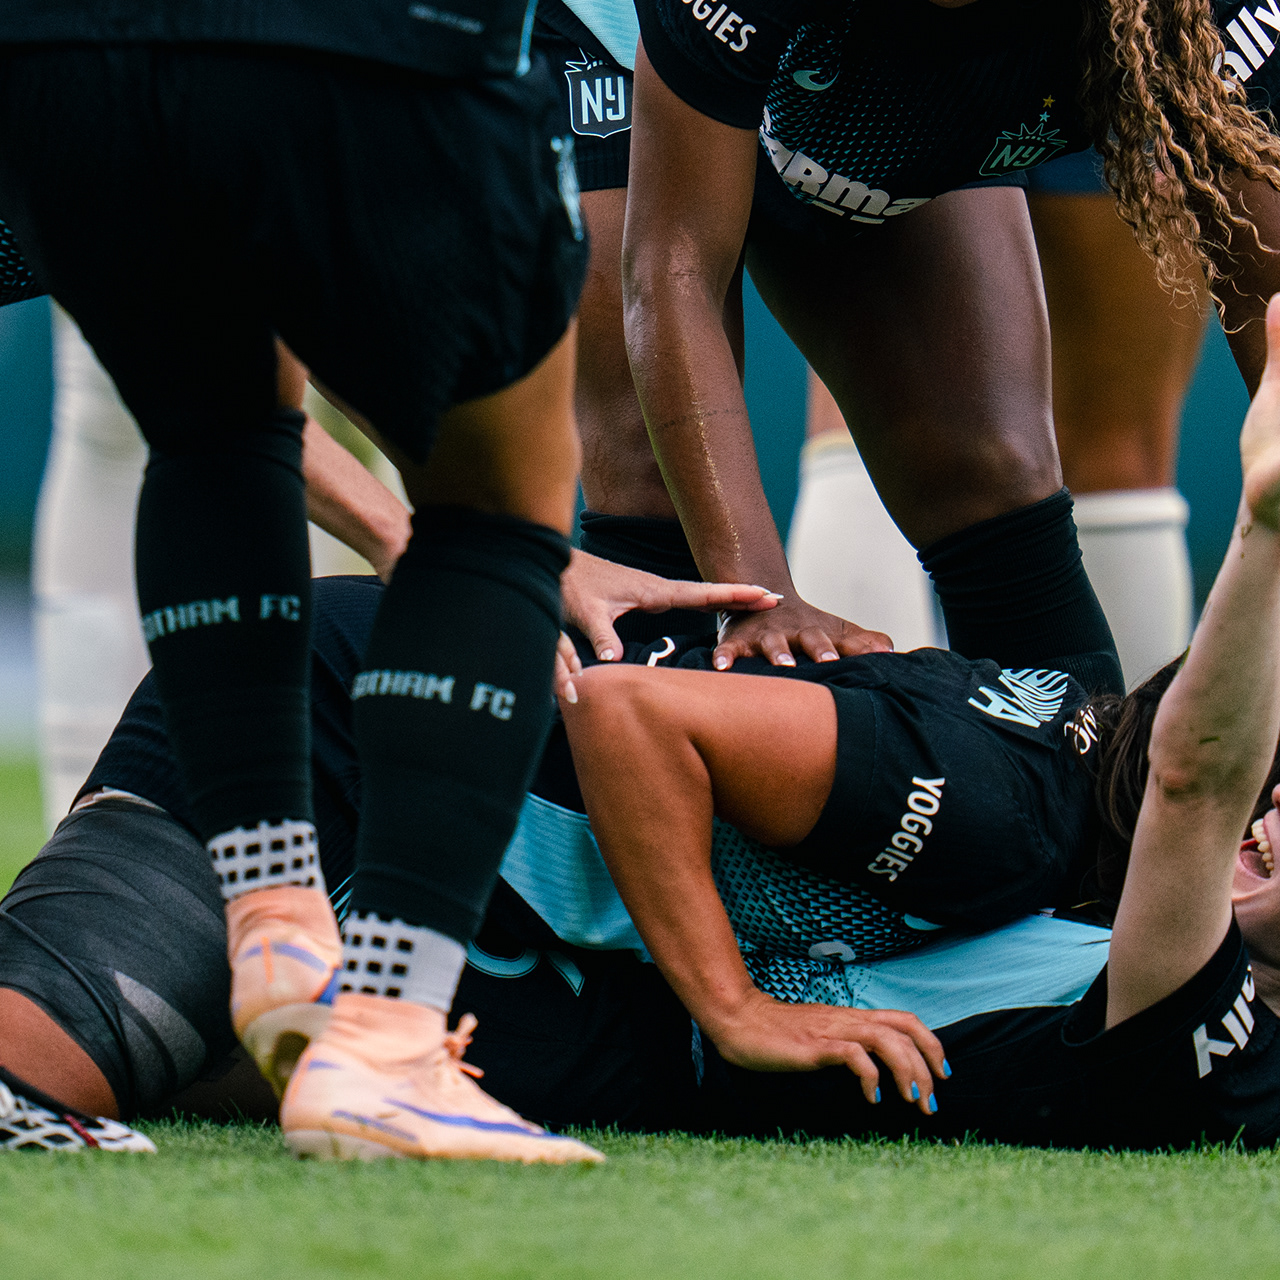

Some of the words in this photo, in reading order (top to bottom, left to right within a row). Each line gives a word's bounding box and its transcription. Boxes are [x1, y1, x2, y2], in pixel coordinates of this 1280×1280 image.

[580, 75, 626, 125] NY
[258, 593, 302, 622] FC
[468, 681, 517, 721] FC
[866, 775, 946, 883] YOGGIES
